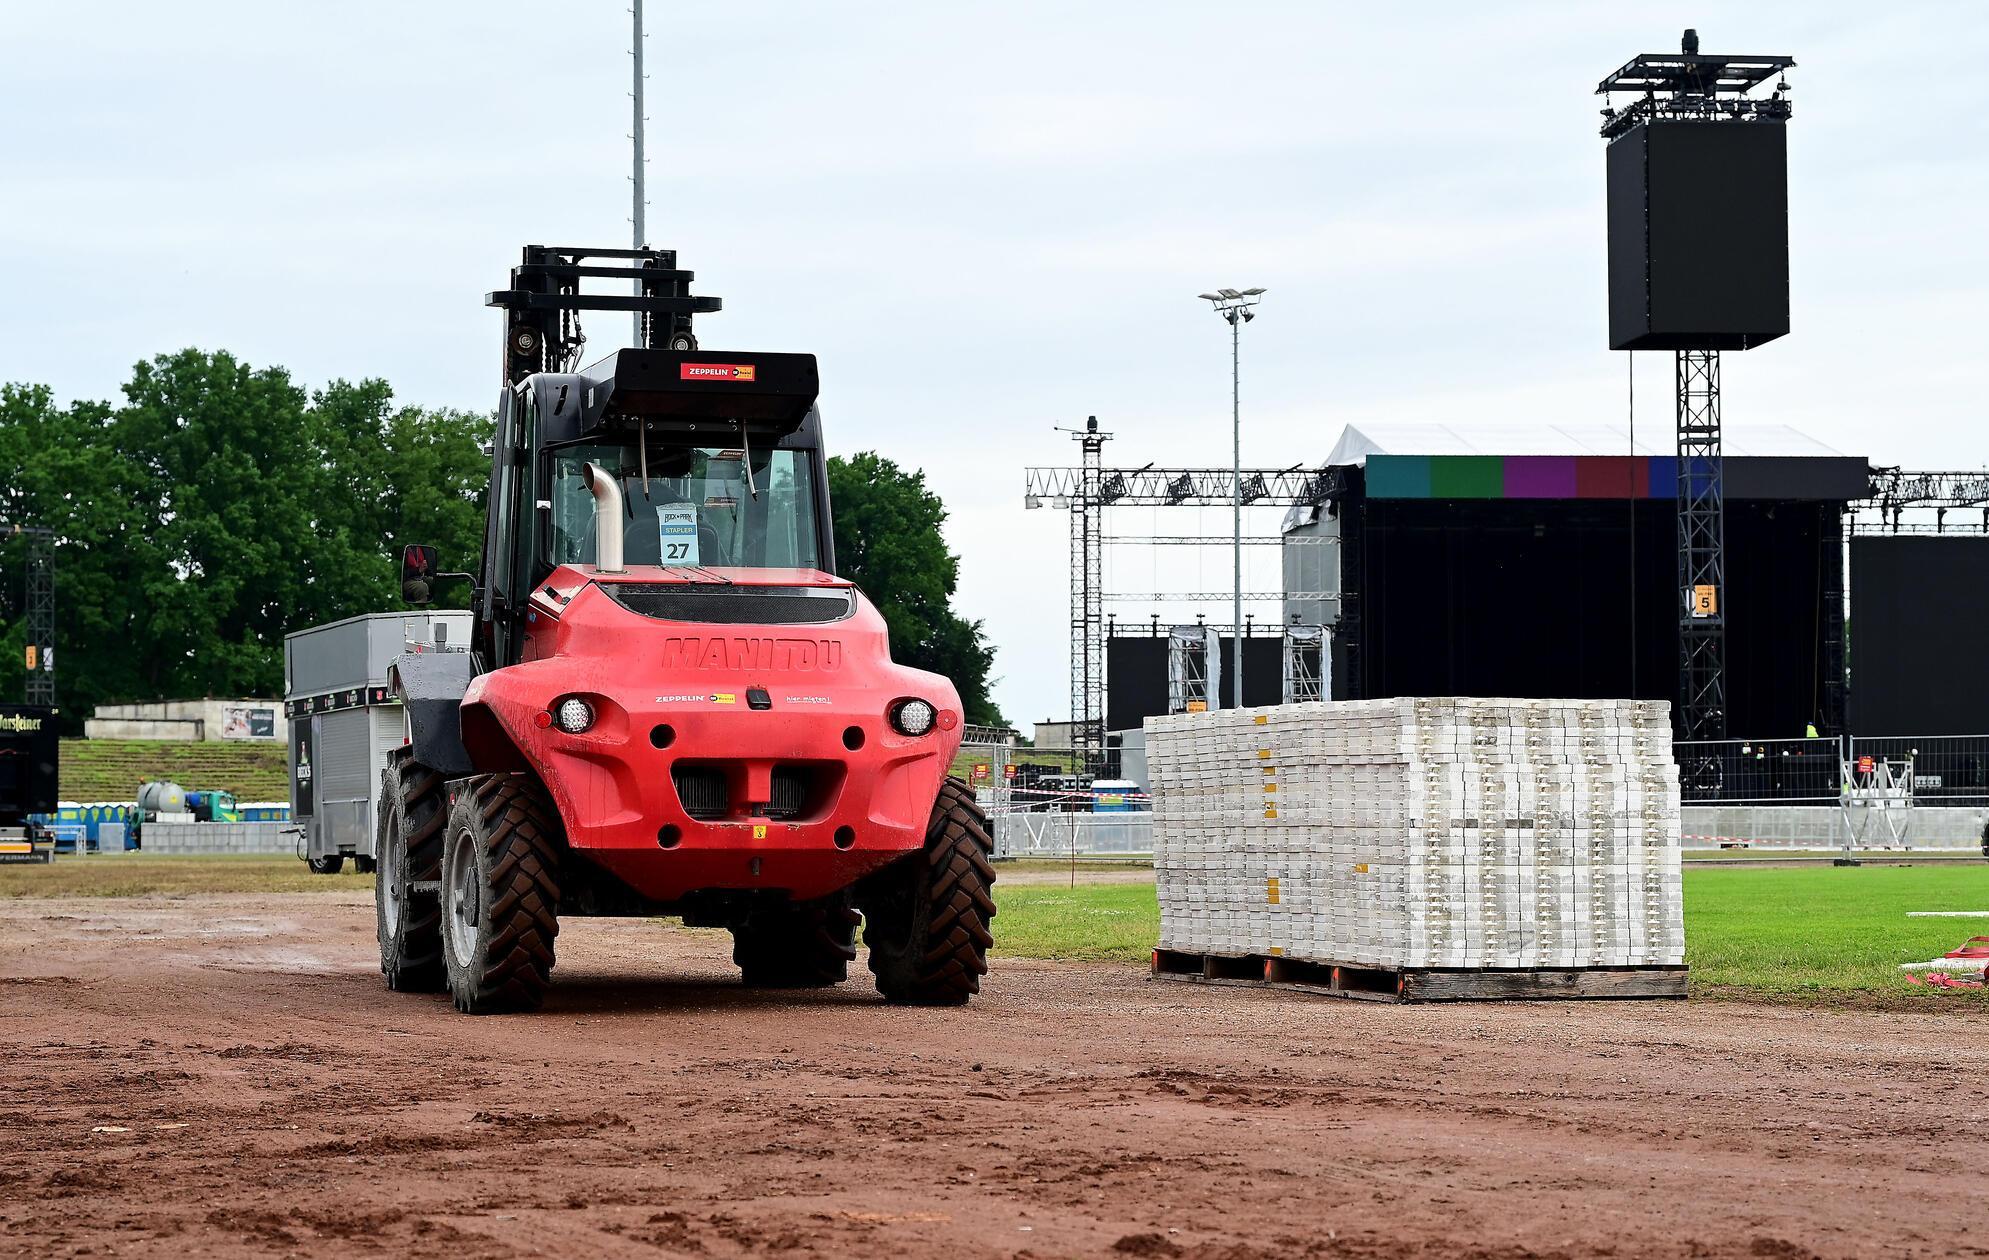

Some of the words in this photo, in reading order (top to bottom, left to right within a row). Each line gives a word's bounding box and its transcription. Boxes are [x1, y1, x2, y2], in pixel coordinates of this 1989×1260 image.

[666, 543, 690, 559] 27
[1701, 597, 1710, 608] 5
[661, 637, 842, 673] MANITOU
[655, 695, 705, 703] ZEPPELIN
